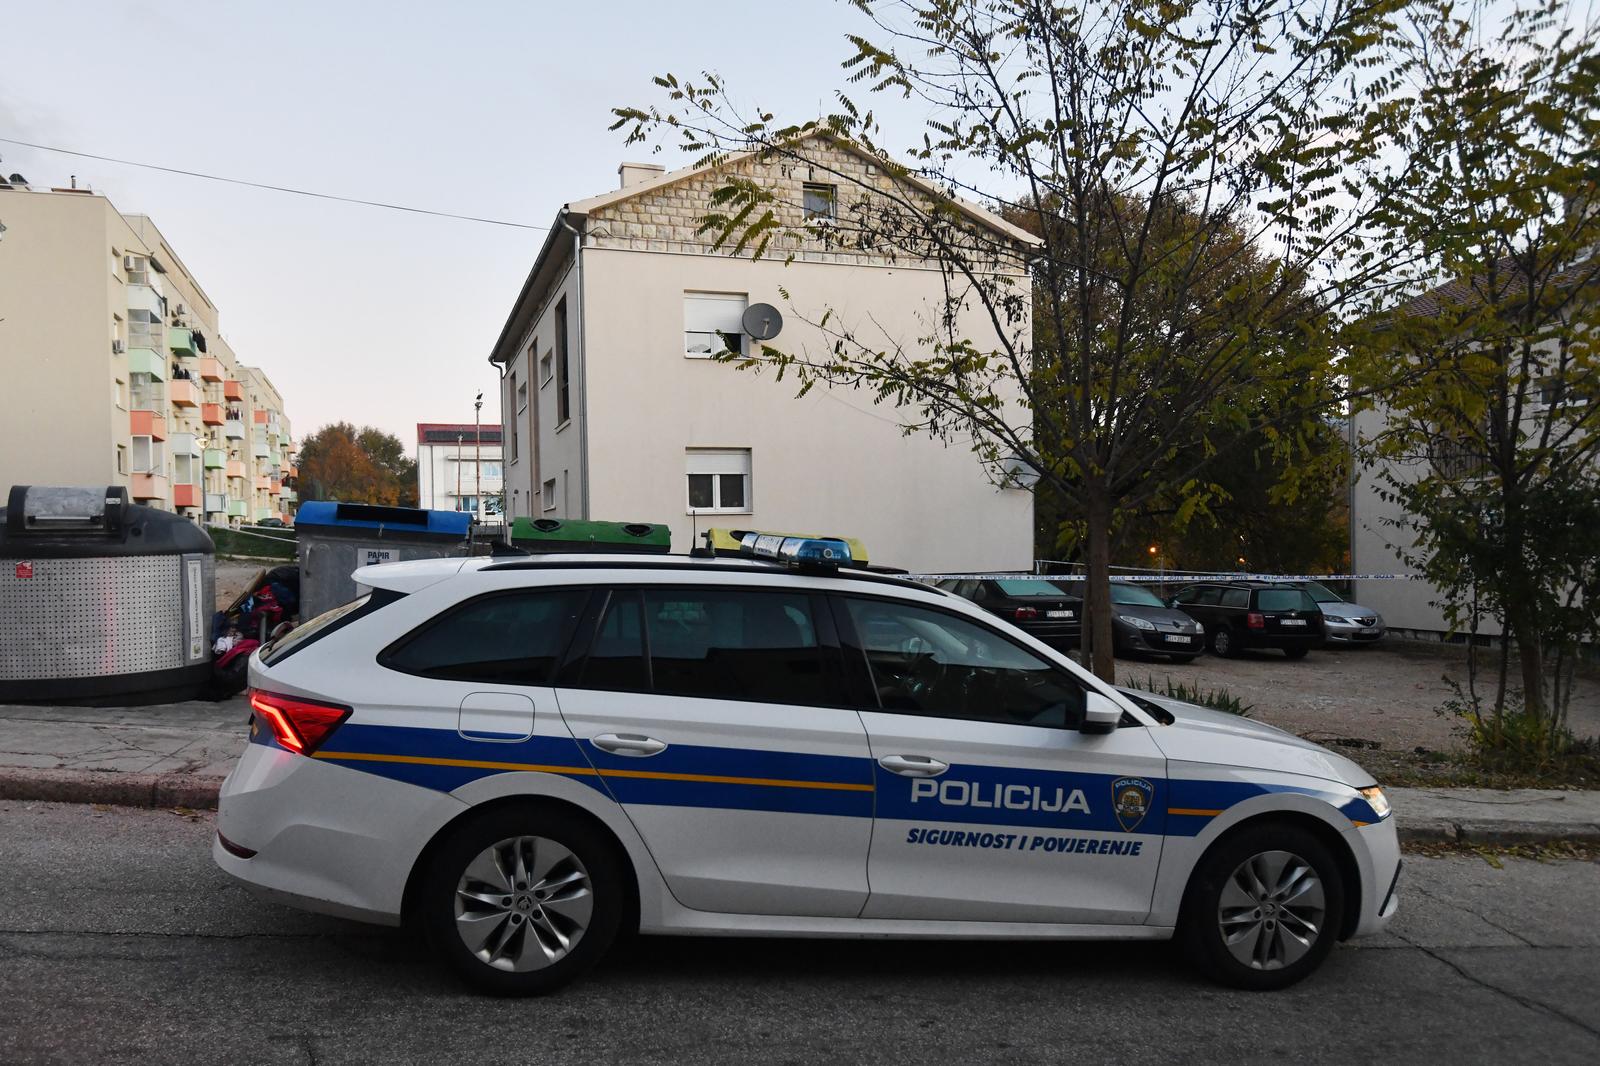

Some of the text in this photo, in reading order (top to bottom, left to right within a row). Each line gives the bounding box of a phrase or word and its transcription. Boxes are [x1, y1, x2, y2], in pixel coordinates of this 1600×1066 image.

[367, 551, 390, 560] PAPIR
[1115, 780, 1151, 791] POLICIJA
[910, 778, 1091, 814] POLICIJA
[907, 828, 1143, 857] SIGURNOST I POVJERENJE
